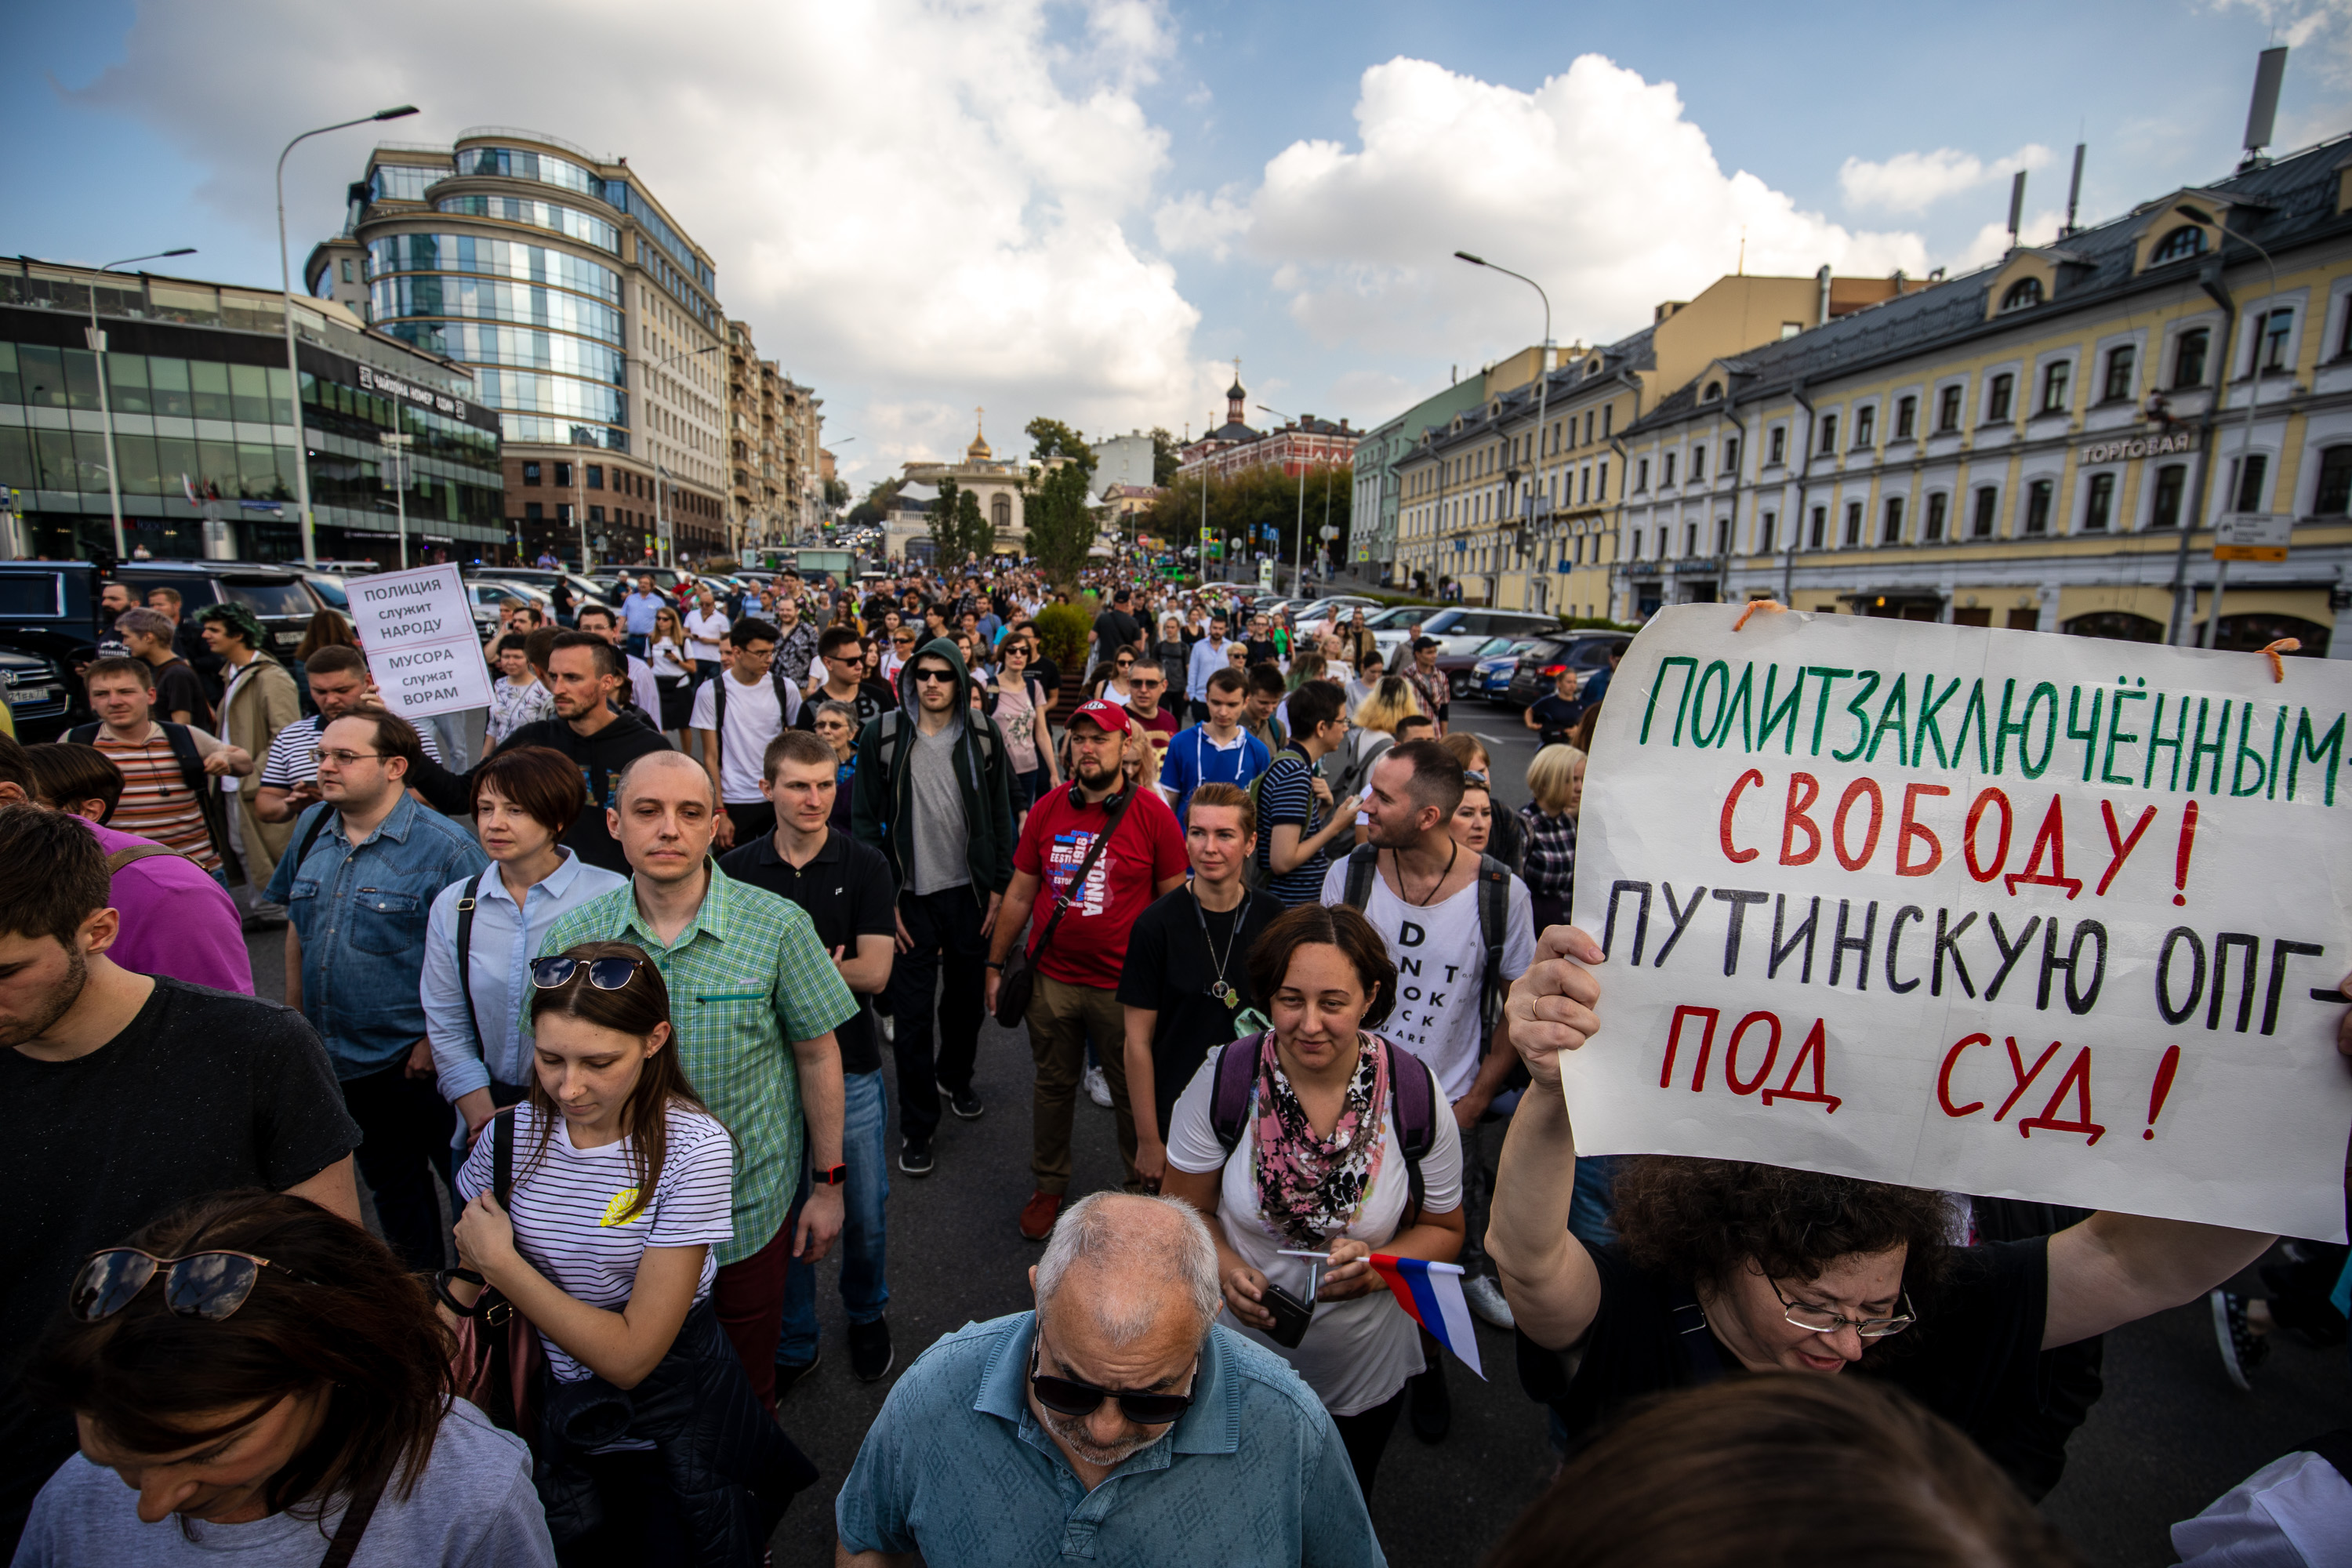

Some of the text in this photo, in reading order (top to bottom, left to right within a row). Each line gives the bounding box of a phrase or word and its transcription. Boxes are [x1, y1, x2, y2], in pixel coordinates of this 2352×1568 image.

[2081, 432, 2190, 464] ТОРГОВАЯ
[364, 579, 441, 602] ПОЛИЦИЯ
[379, 602, 431, 621] служит
[380, 619, 442, 640] НАРОДУ
[389, 648, 454, 670] МУСОРА
[402, 670, 453, 688] служат
[403, 687, 459, 706] ВОРАМ
[1639, 655, 2352, 808] ПОЛИТЗАКЛЮЧЁННЫМ
[1719, 768, 2198, 906] СВОБОДУ!
[1050, 852, 1072, 863] EESTI
[1073, 837, 1087, 865] 1918
[1603, 880, 2108, 1016] ПУТИНСКУЮ
[1396, 1029, 1426, 1045] ARE
[1660, 1004, 2180, 1147] ПОД СУД!
[605, 1190, 639, 1218] SUMME
